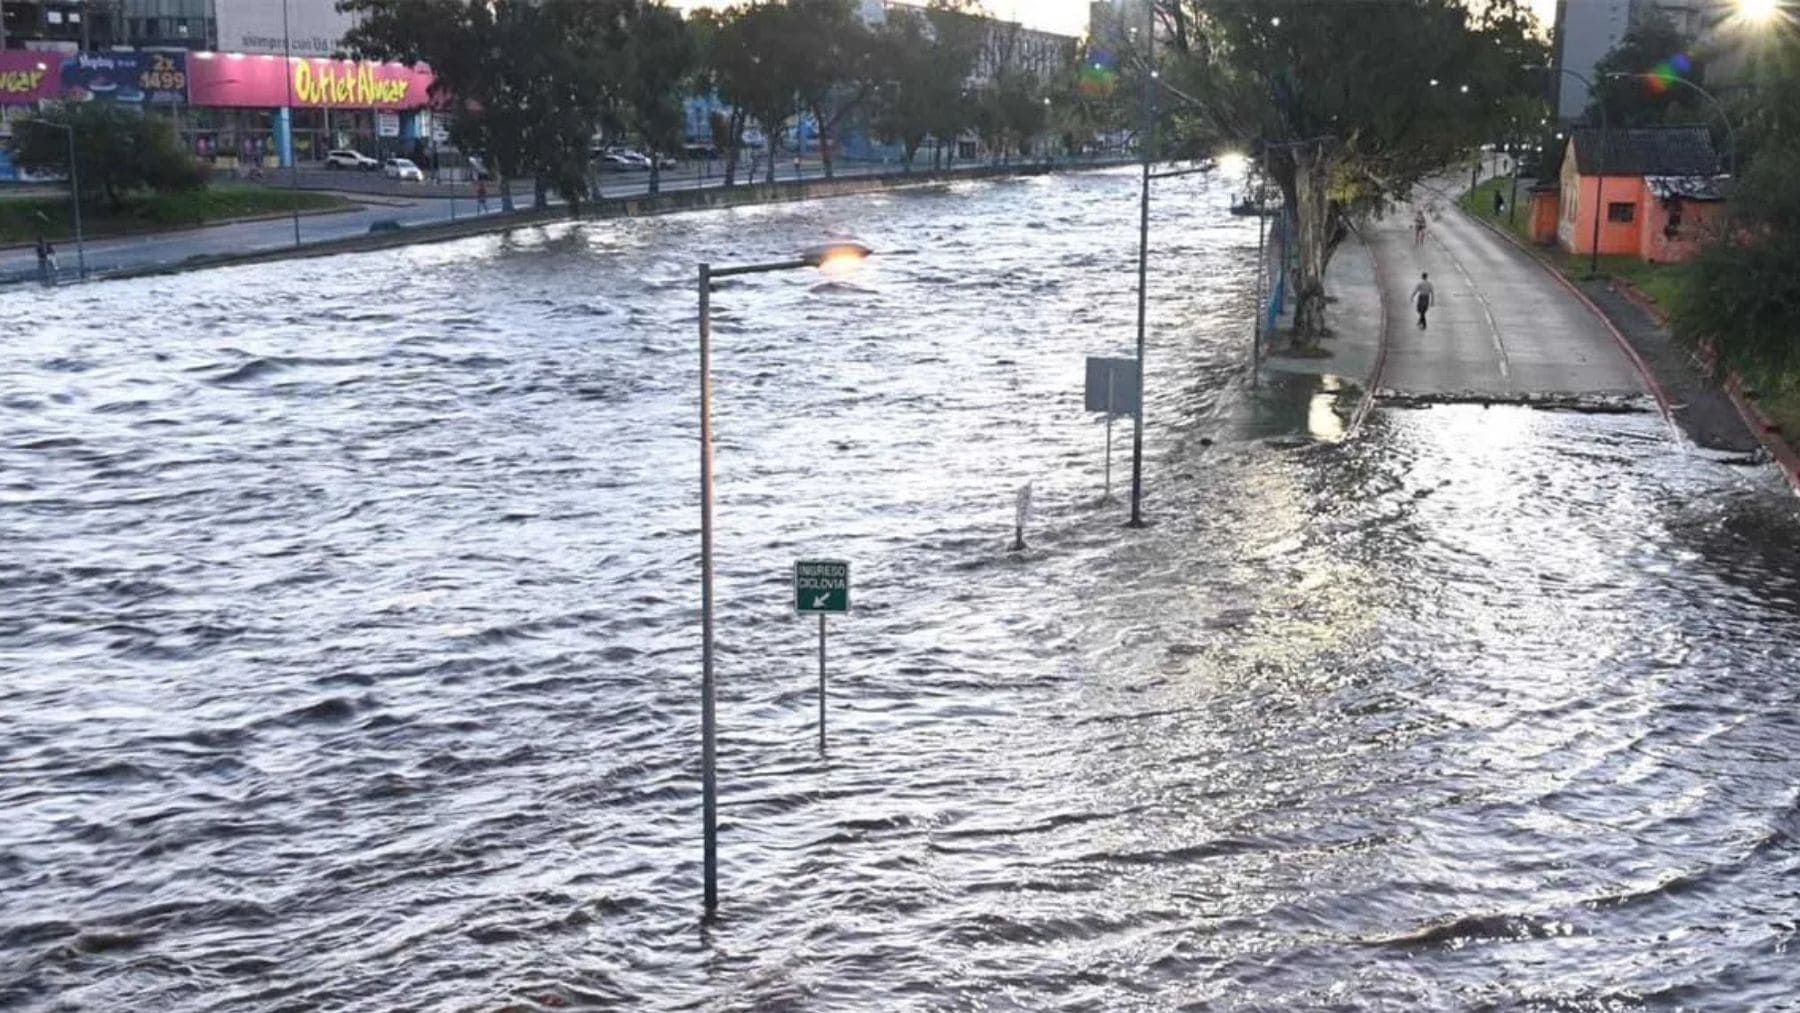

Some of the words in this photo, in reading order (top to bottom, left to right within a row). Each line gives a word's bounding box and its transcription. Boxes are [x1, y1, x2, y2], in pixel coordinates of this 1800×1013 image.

[295, 59, 357, 104] Outlet
[358, 62, 409, 105] Alvear
[799, 564, 845, 577] INGRESO
[799, 577, 845, 590] CICLOVIA
